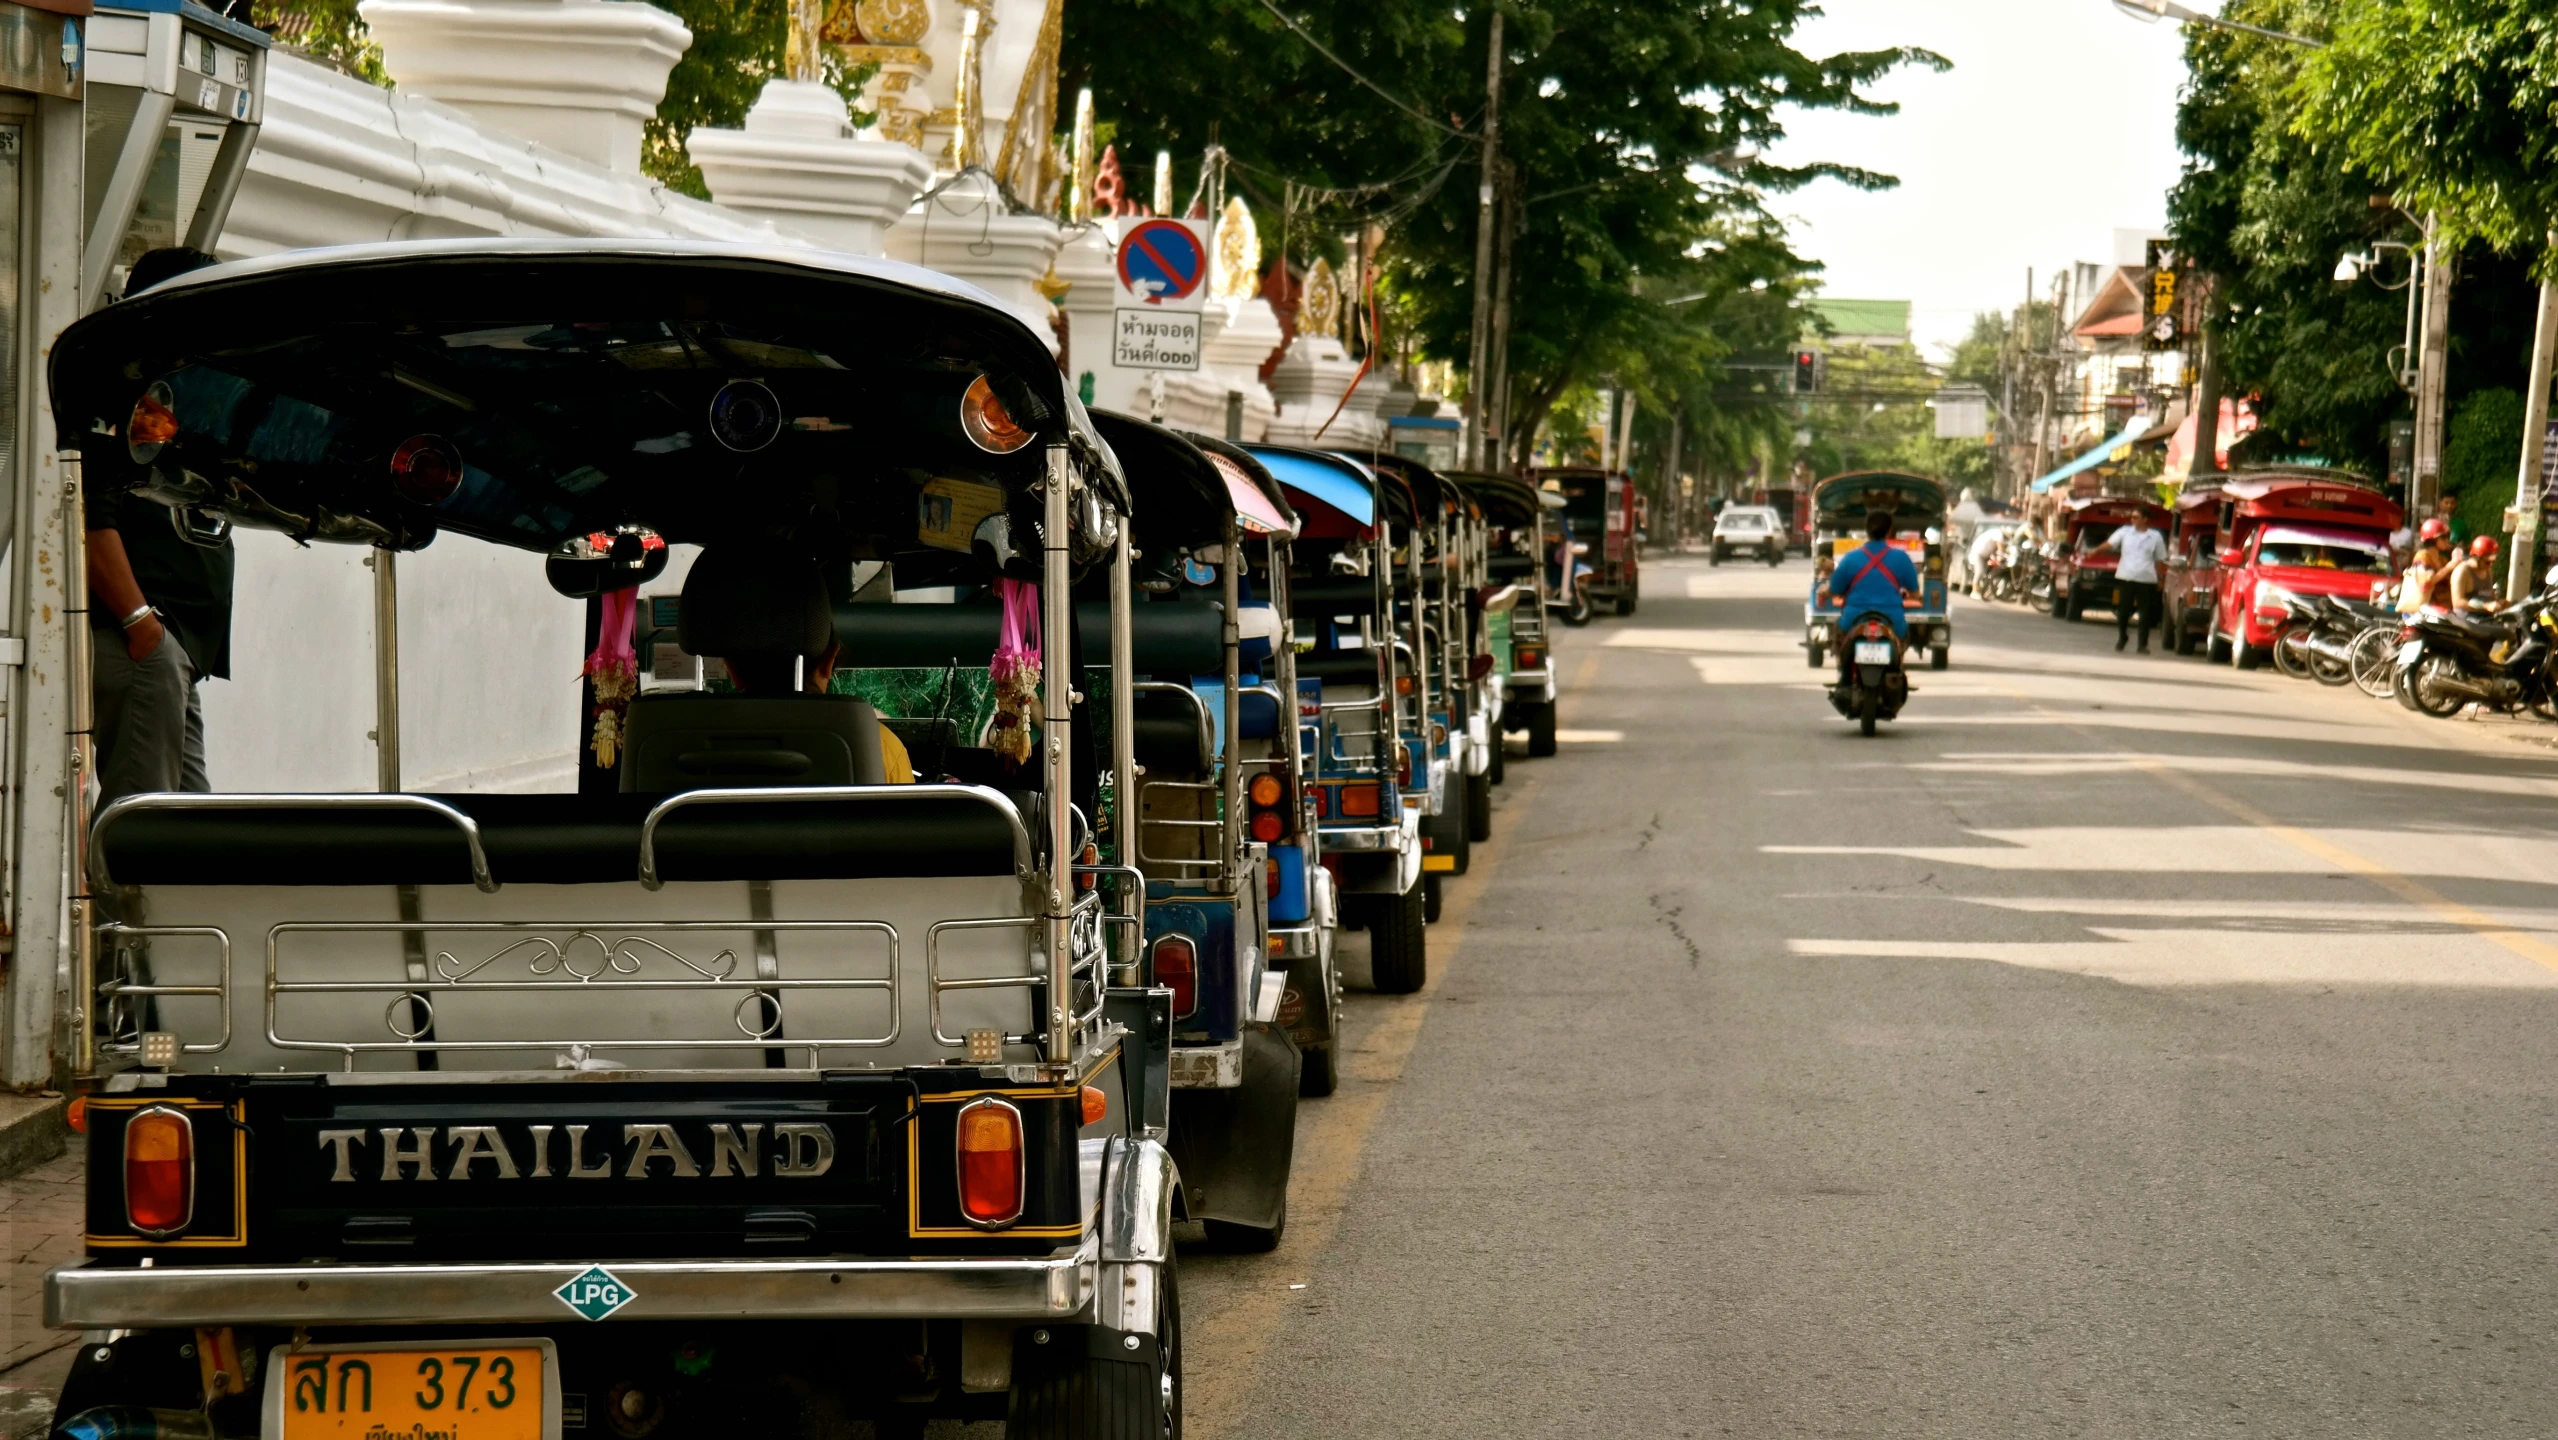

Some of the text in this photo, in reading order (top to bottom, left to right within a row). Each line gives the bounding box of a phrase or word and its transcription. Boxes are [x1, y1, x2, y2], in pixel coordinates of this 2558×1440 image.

[1122, 314, 1195, 338] ห้ามจอด
[318, 1123, 835, 1182] THAILAND
[570, 1283, 619, 1306] LPG
[294, 1355, 517, 1413] สก 373
